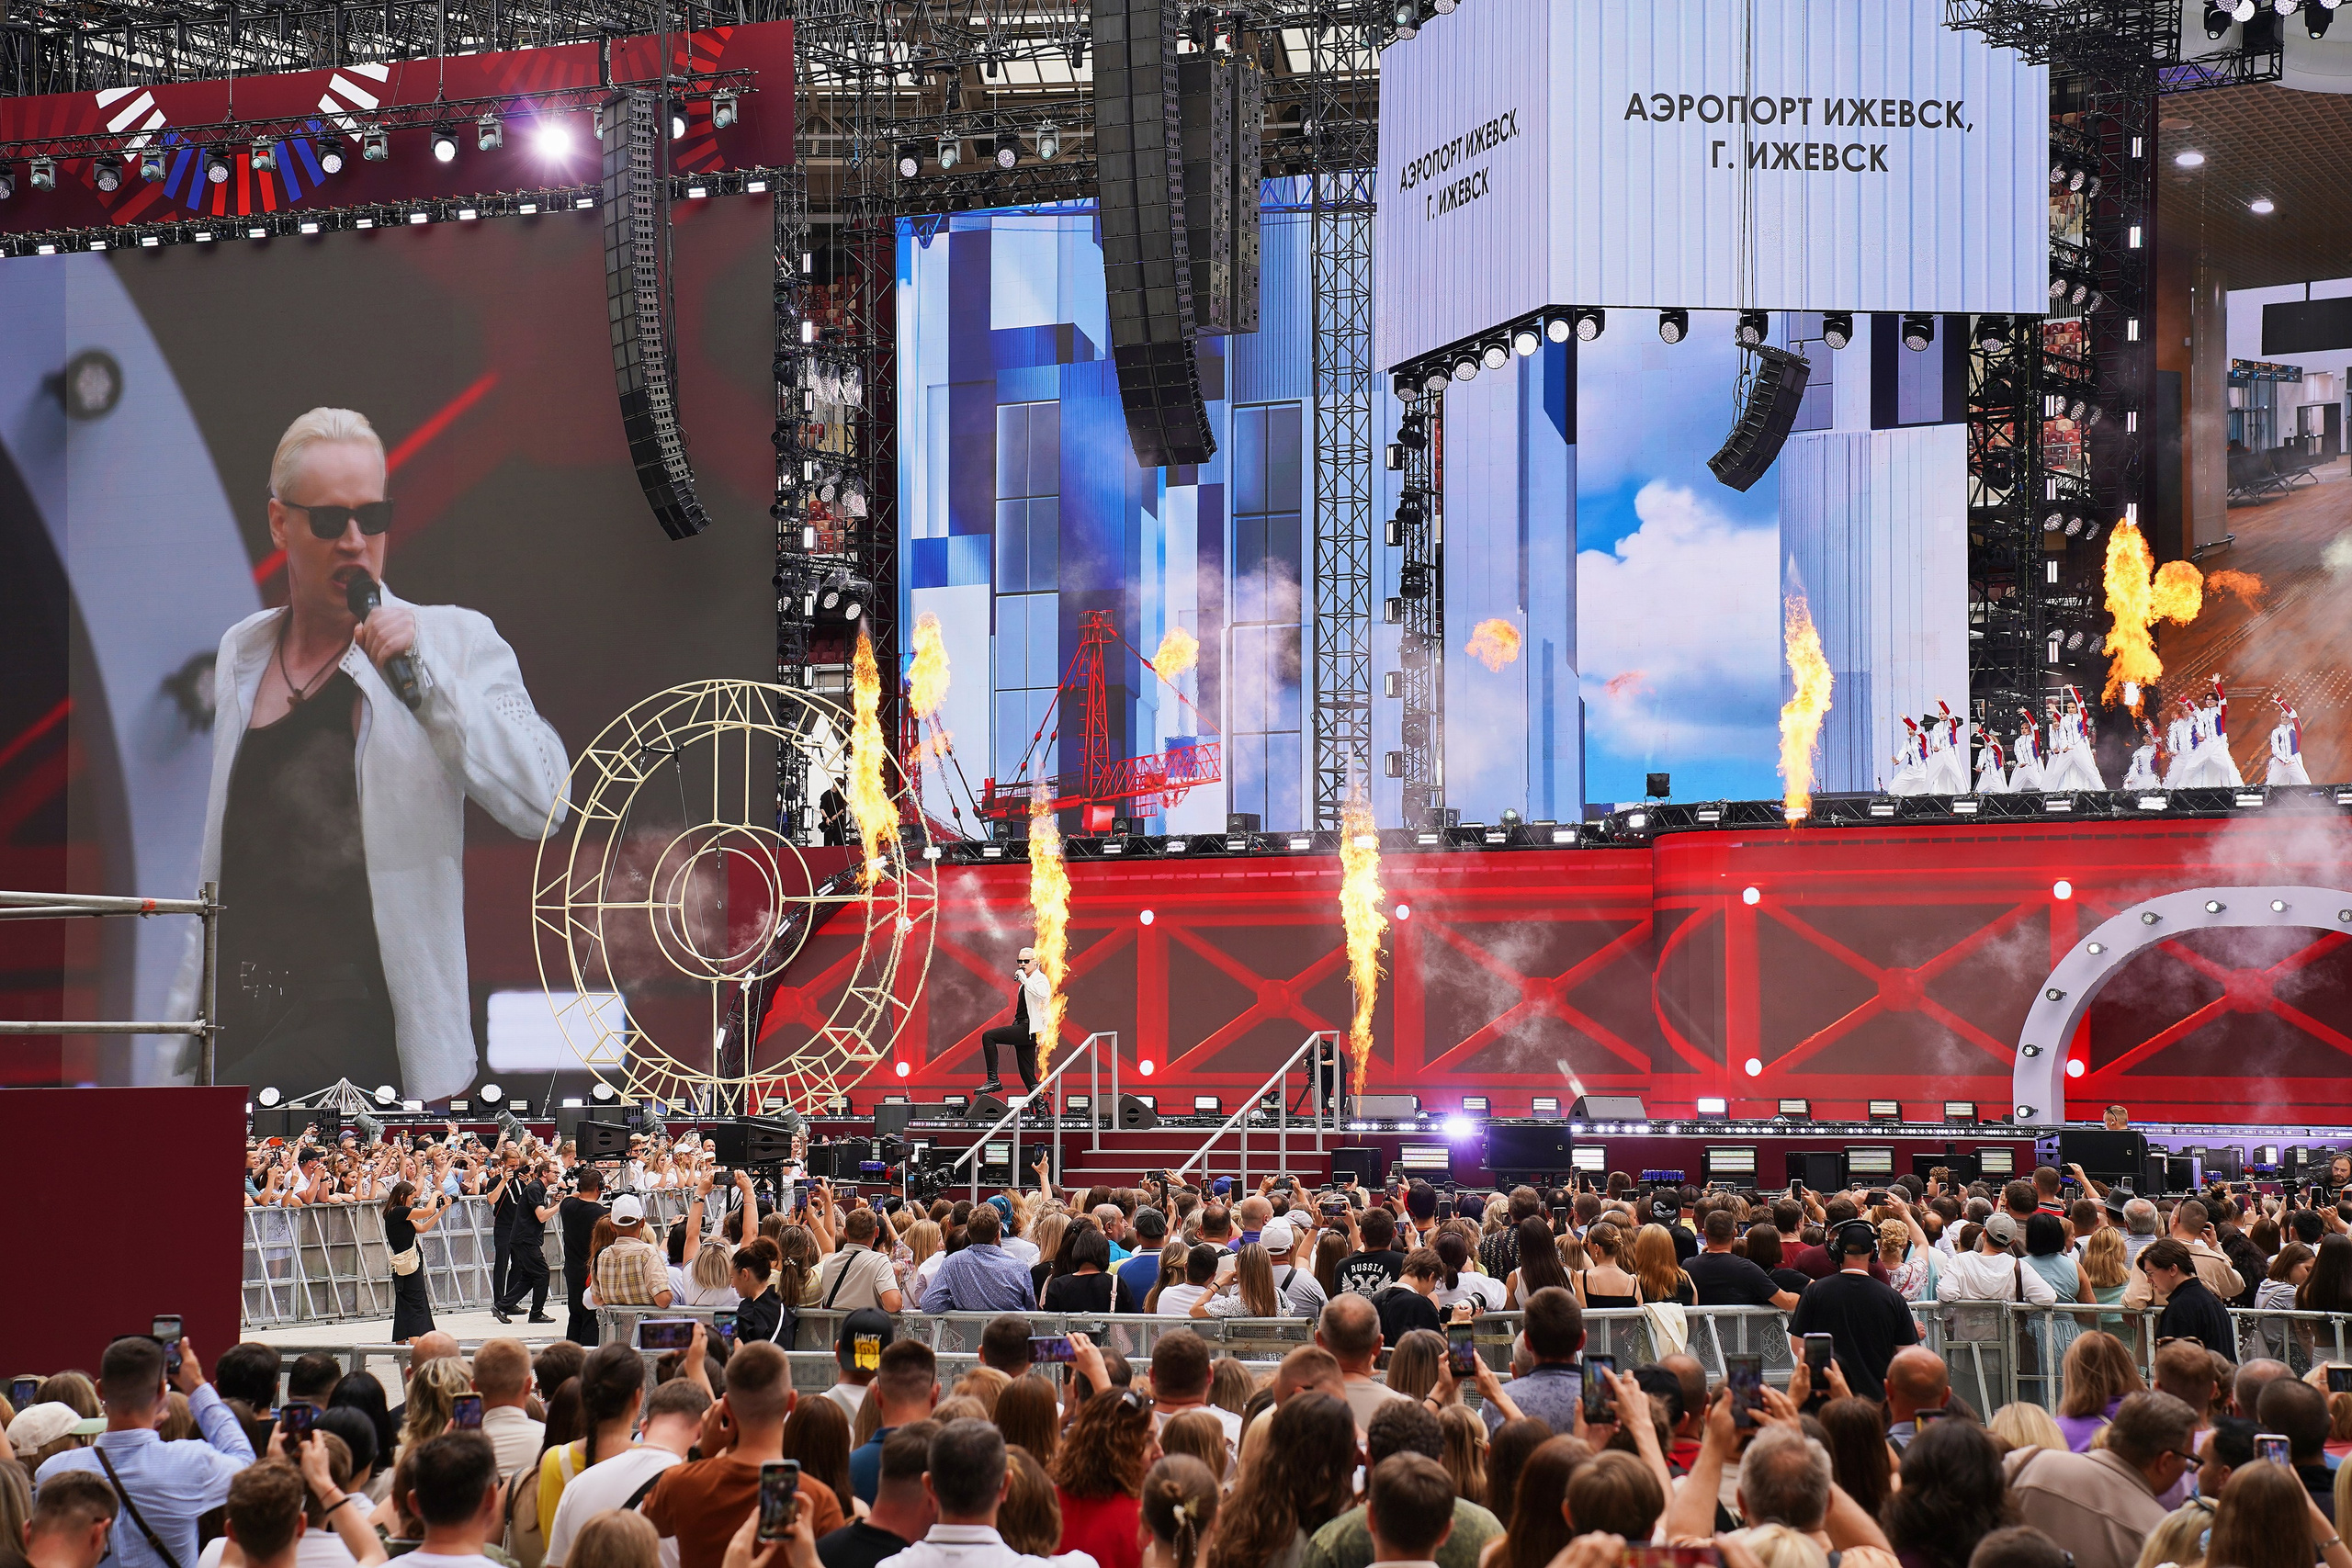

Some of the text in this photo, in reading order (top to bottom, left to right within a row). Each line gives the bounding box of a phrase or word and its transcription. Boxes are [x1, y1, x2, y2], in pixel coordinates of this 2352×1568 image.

[1624, 93, 1973, 133] АЭРОПОРТ ИЖЕВСК,
[1399, 107, 1521, 194] АЭРОПОРТ ИЖЕВСК,
[1712, 141, 1889, 172] Г. ИЖЕВСК
[1427, 166, 1489, 222] Г. ИЖЕВСК
[1351, 1262, 1384, 1274] RUSSIA
[854, 1331, 882, 1344] UNITY
